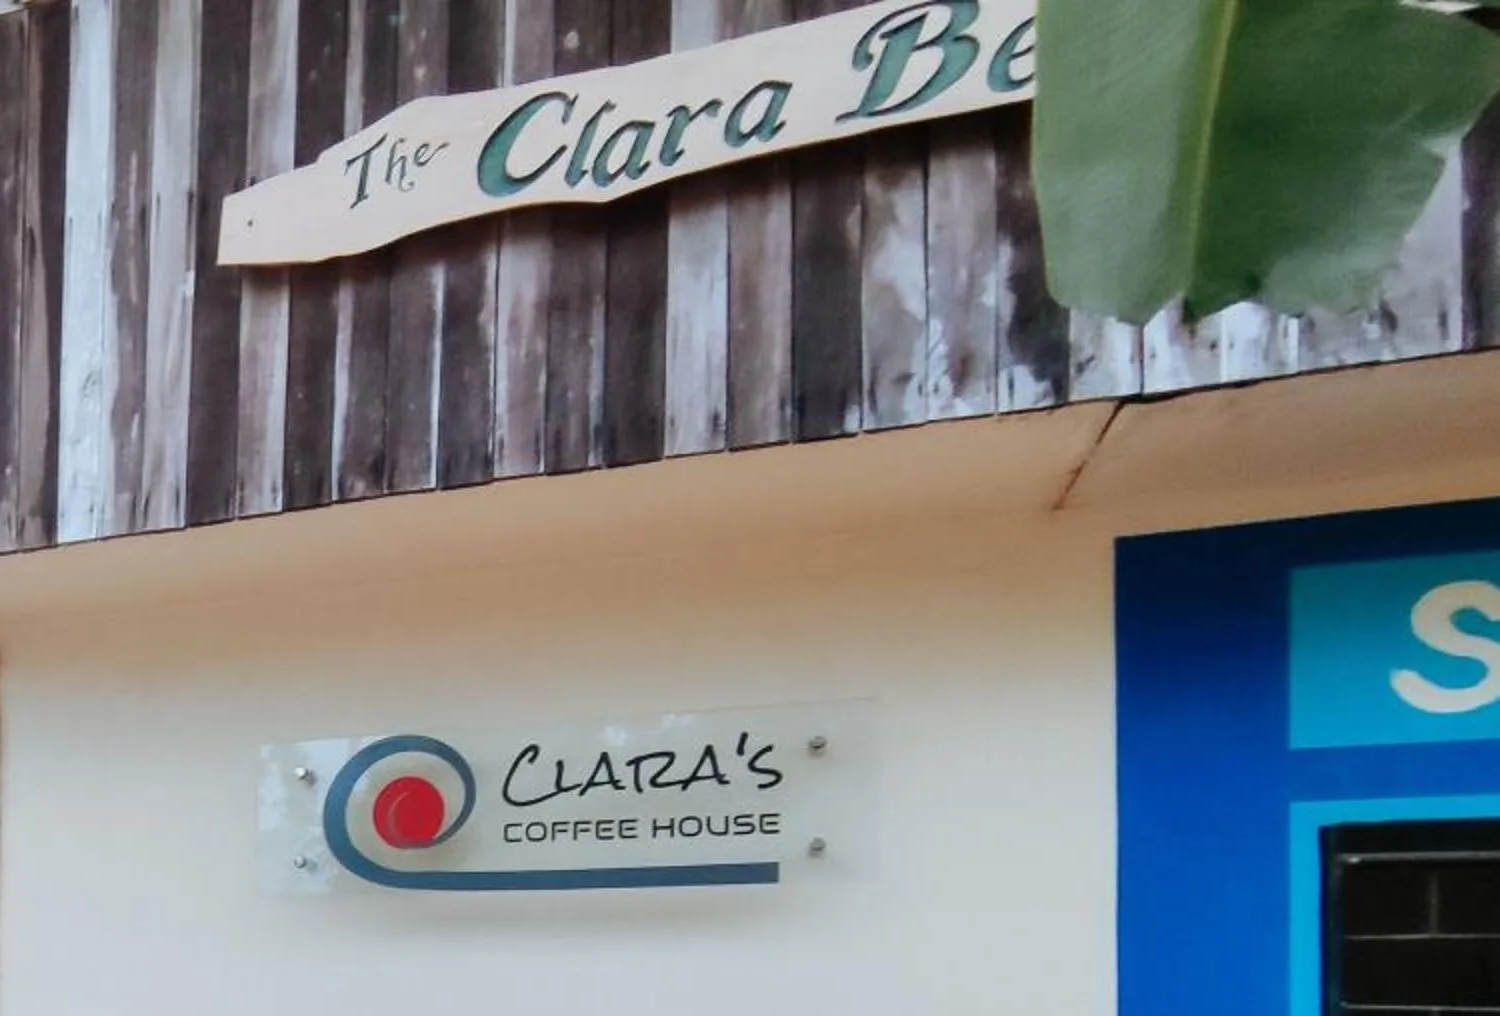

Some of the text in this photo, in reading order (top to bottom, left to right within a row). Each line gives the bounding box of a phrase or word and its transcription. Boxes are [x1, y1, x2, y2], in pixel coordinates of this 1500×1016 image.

[344, 133, 450, 210] The
[477, 79, 794, 198] Clara
[502, 731, 783, 806] CLARA'S
[503, 813, 781, 843] COFFEE HOUSE
